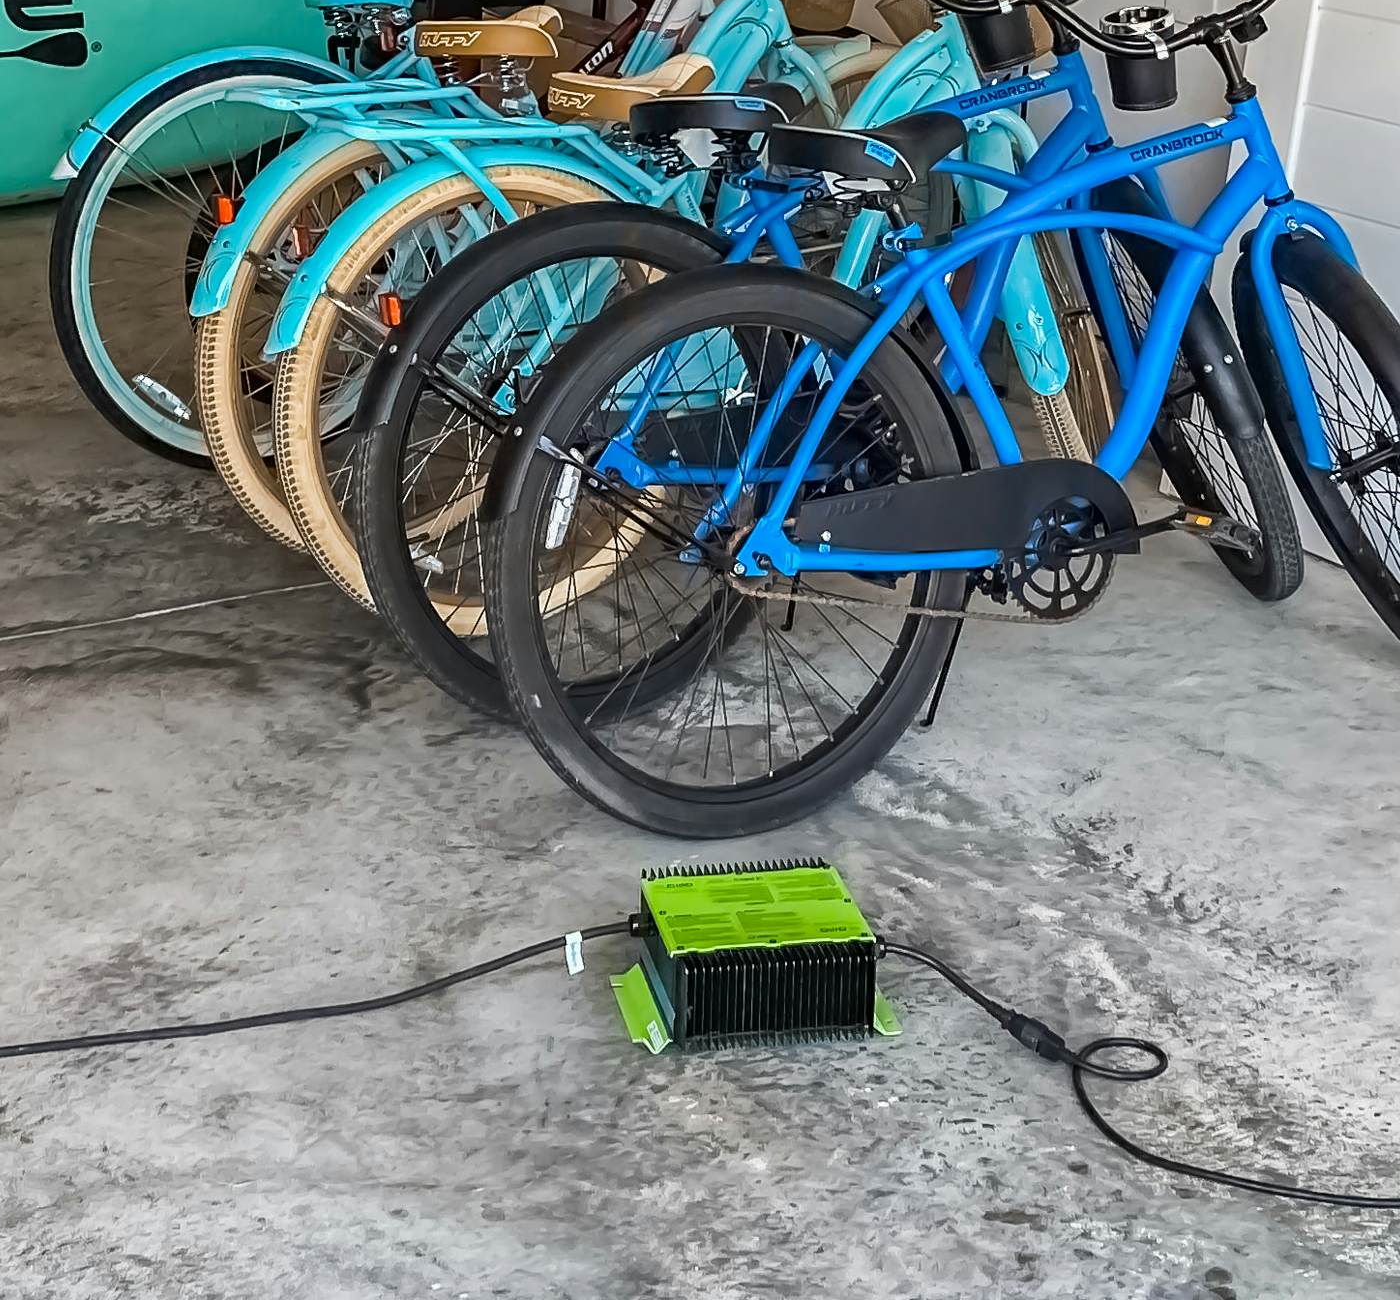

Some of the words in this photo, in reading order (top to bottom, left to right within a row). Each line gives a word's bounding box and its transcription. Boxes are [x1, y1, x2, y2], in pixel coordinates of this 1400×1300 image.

[419, 31, 483, 48] HUFFY
[959, 79, 1047, 110] CRANBROOK
[1129, 128, 1225, 162] CRANBROOK
